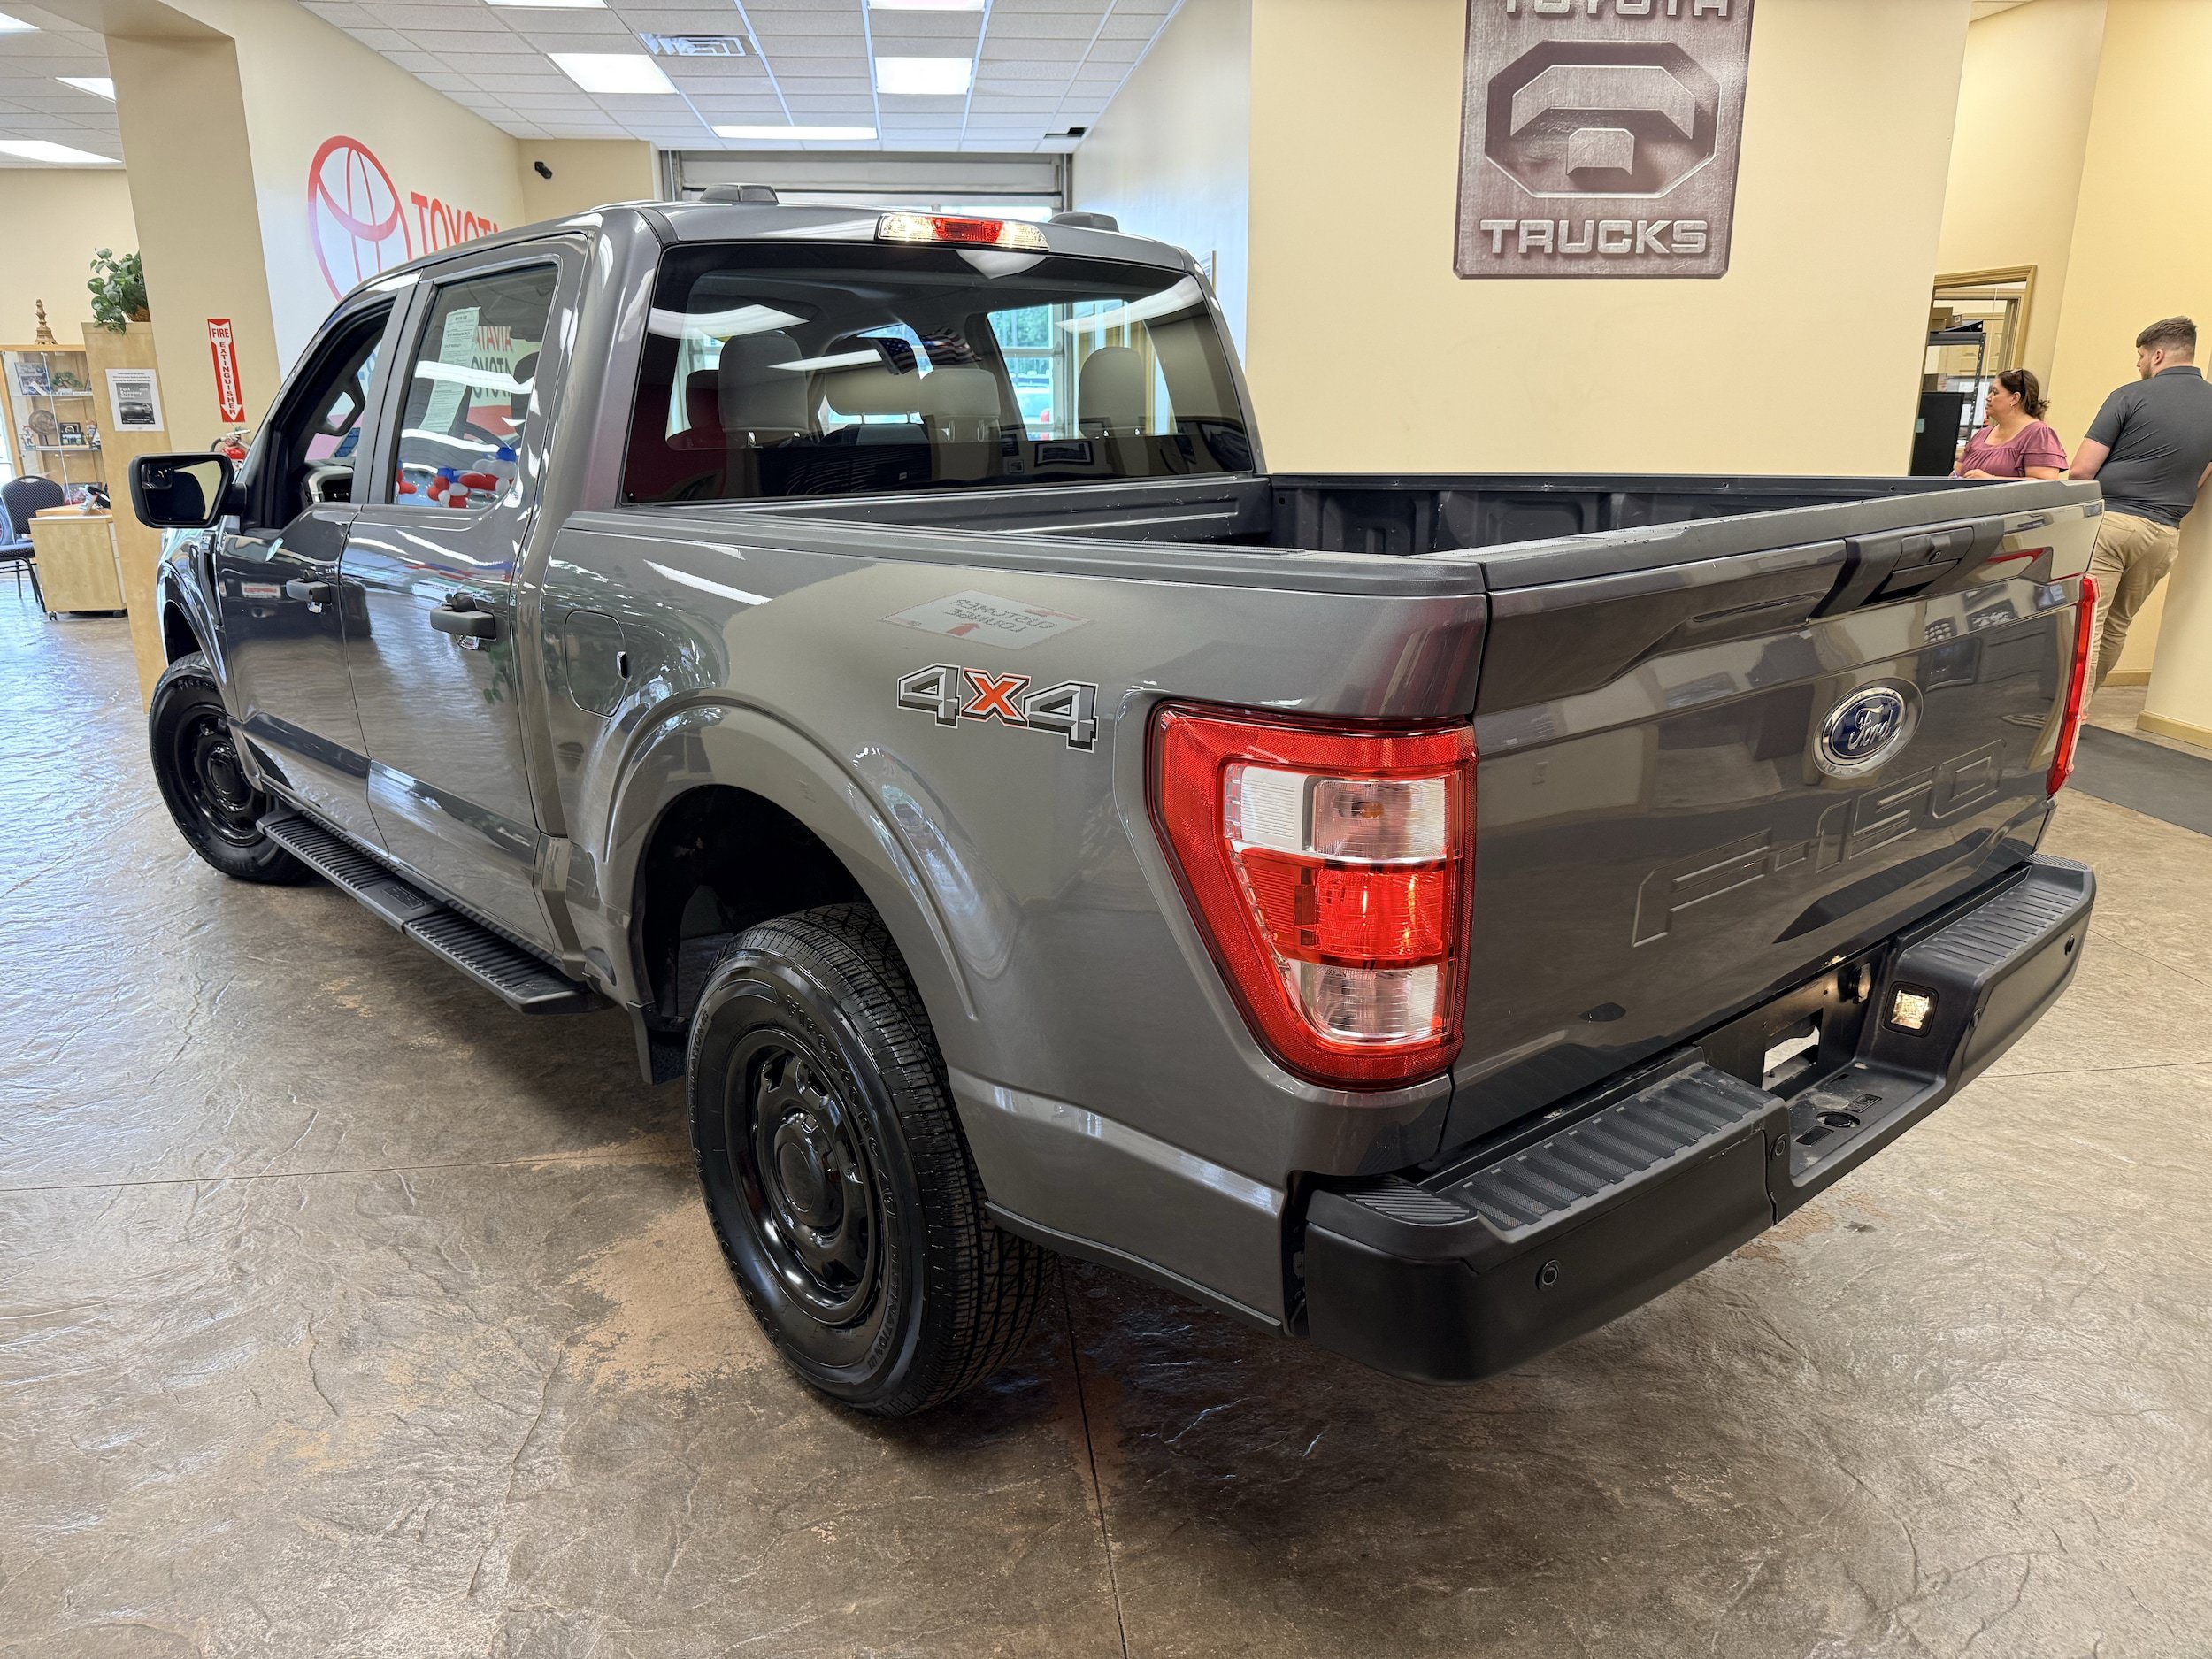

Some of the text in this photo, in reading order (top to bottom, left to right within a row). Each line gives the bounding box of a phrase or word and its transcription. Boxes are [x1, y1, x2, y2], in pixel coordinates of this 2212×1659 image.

[410, 190, 499, 256] TOYOT
[1480, 219, 1708, 255] TRUCKS
[211, 328, 229, 338] FIRE
[219, 342, 236, 415] EXTINGUISHER
[1847, 705, 1893, 750] Ford
[1632, 738, 2007, 948] F-150
